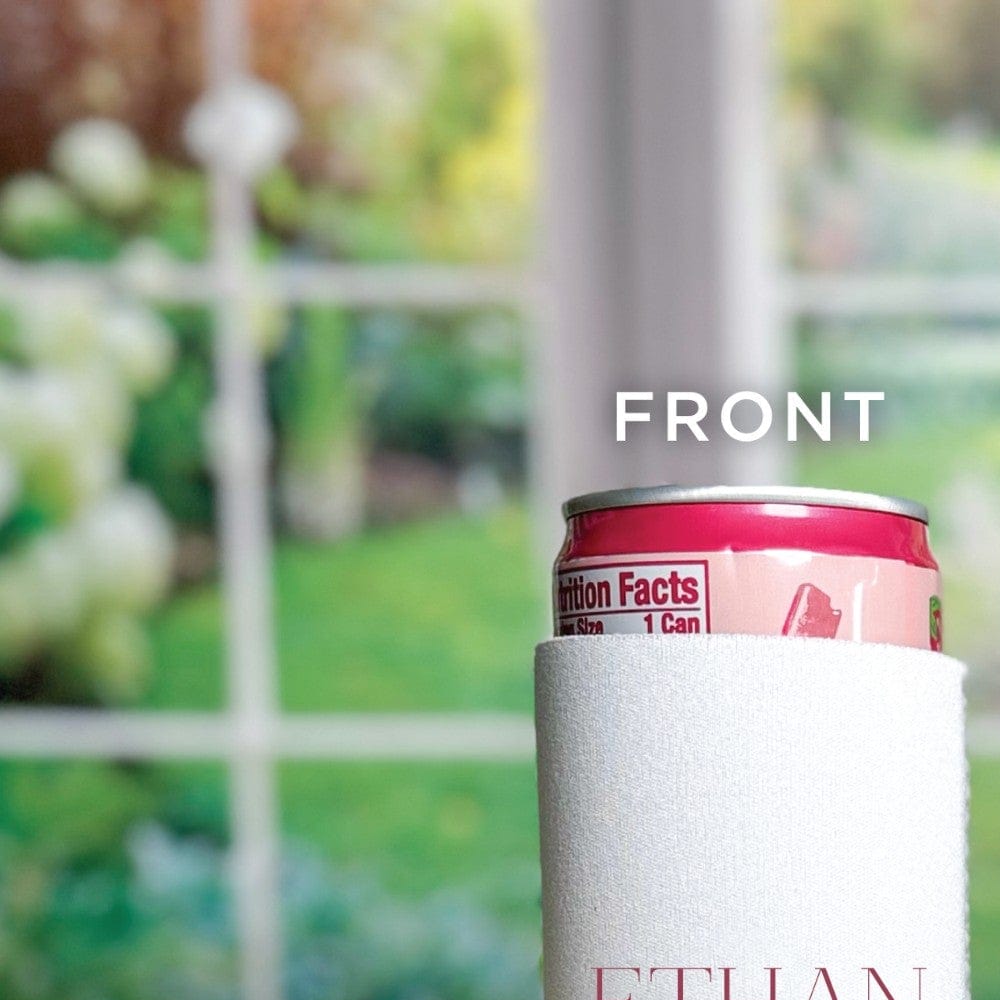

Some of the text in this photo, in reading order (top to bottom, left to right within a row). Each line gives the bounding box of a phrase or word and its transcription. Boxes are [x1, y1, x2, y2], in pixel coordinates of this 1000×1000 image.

[619, 571, 699, 607] Facts
[643, 612, 653, 634] 1
[661, 612, 701, 634] Can
